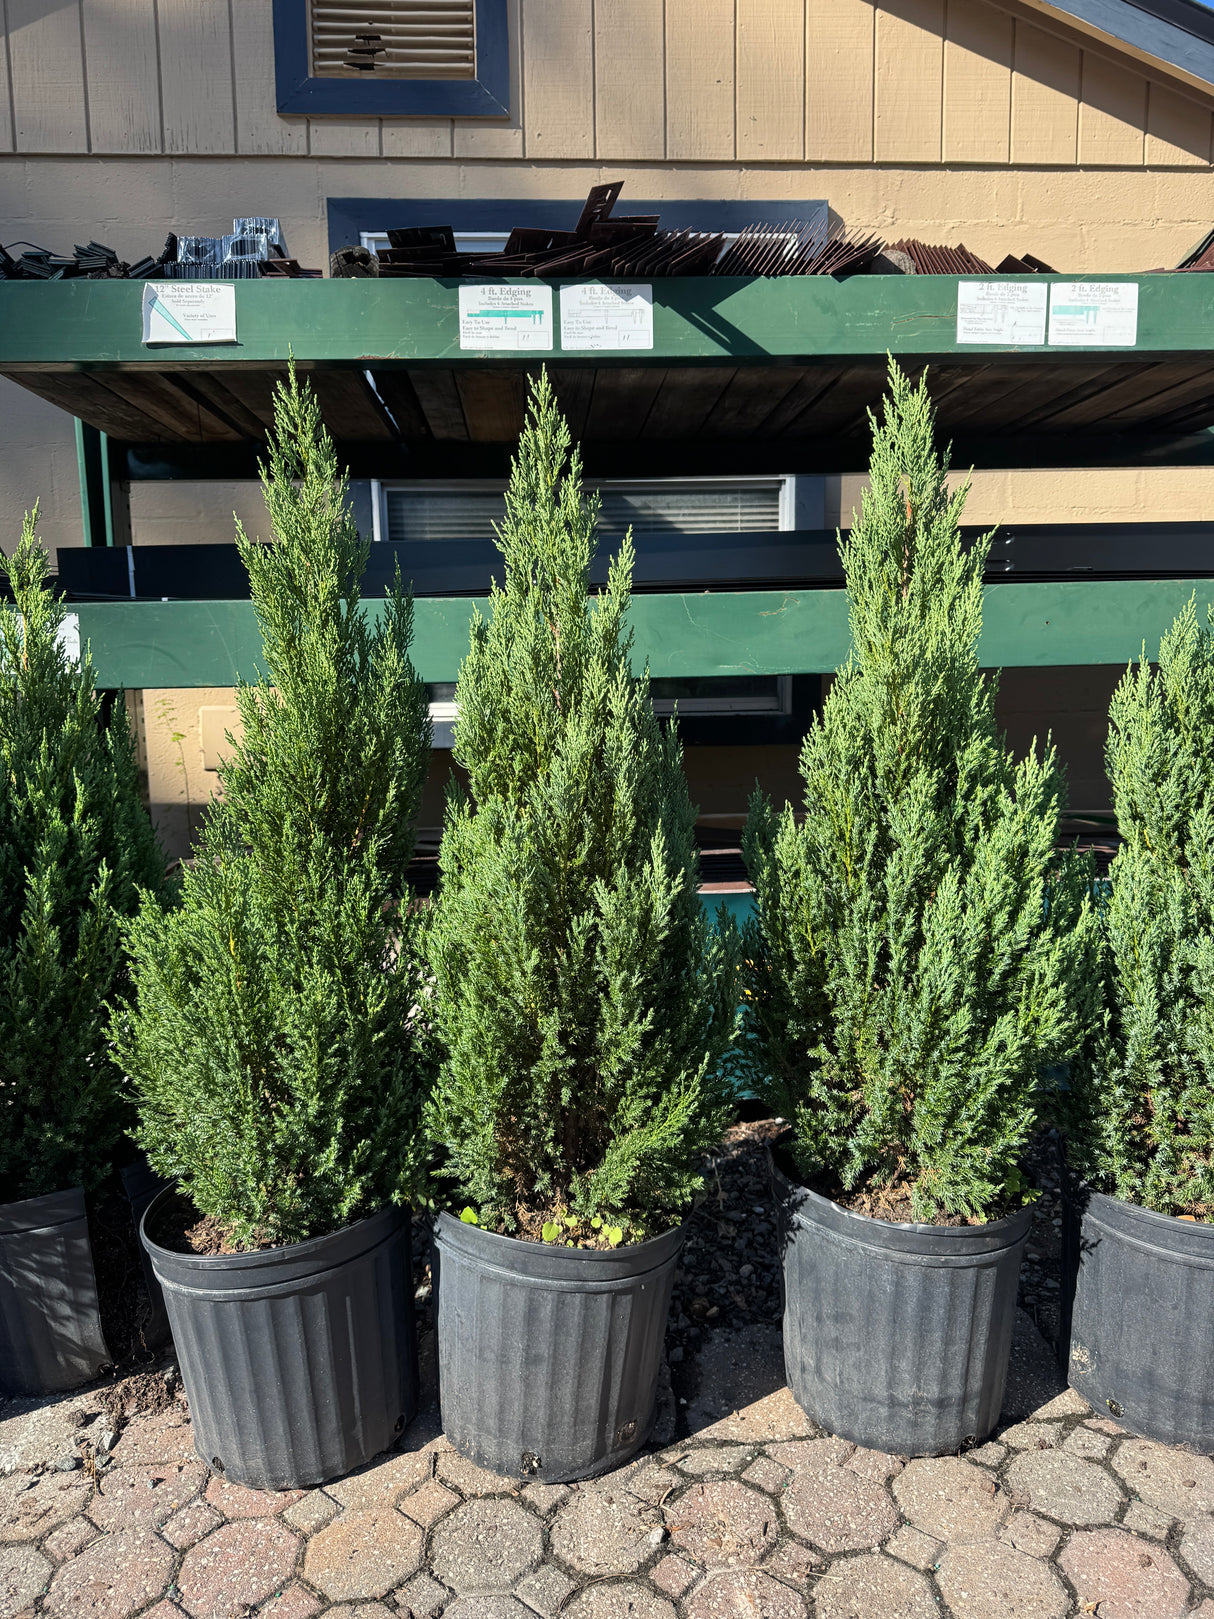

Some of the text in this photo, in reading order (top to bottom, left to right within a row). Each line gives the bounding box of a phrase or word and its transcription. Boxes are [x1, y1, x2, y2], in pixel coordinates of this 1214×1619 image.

[171, 285, 194, 293] Steel
[196, 285, 221, 294] Stake
[488, 287, 498, 296] ft.
[500, 287, 532, 298] Edging
[589, 286, 598, 295] ft.
[600, 286, 632, 296] Edging
[978, 283, 984, 291] 2
[997, 283, 1028, 294] Edging
[1071, 284, 1120, 295] 2 ft. Edging
